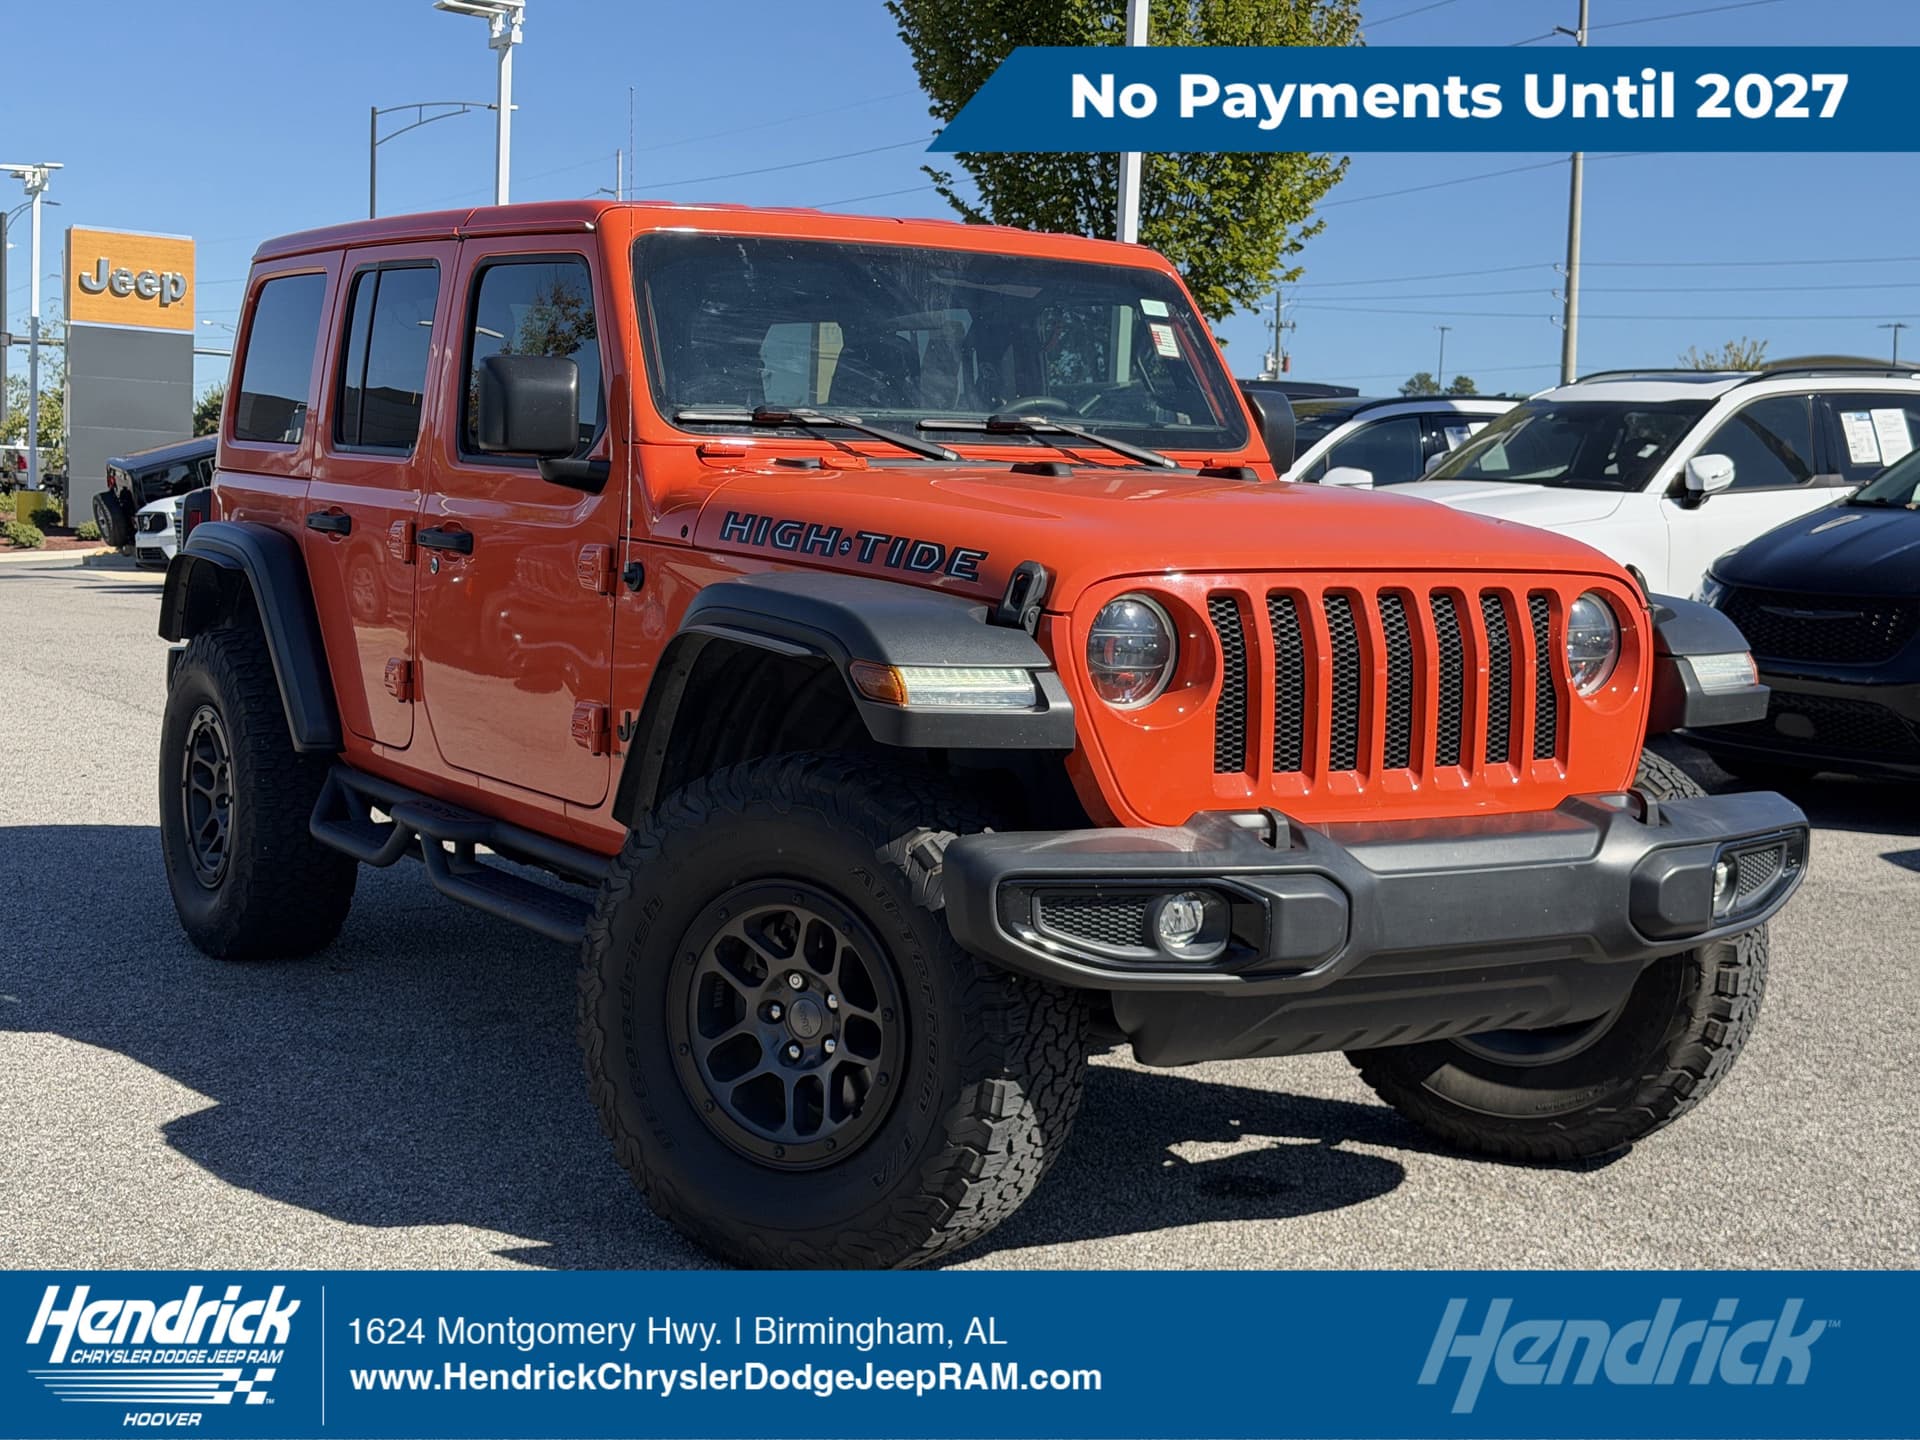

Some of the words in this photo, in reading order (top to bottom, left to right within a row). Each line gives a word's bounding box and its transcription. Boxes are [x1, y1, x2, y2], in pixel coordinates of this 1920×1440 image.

[79, 256, 187, 308] Jeep
[719, 511, 843, 558] HIGH
[855, 530, 989, 582] TIDE
